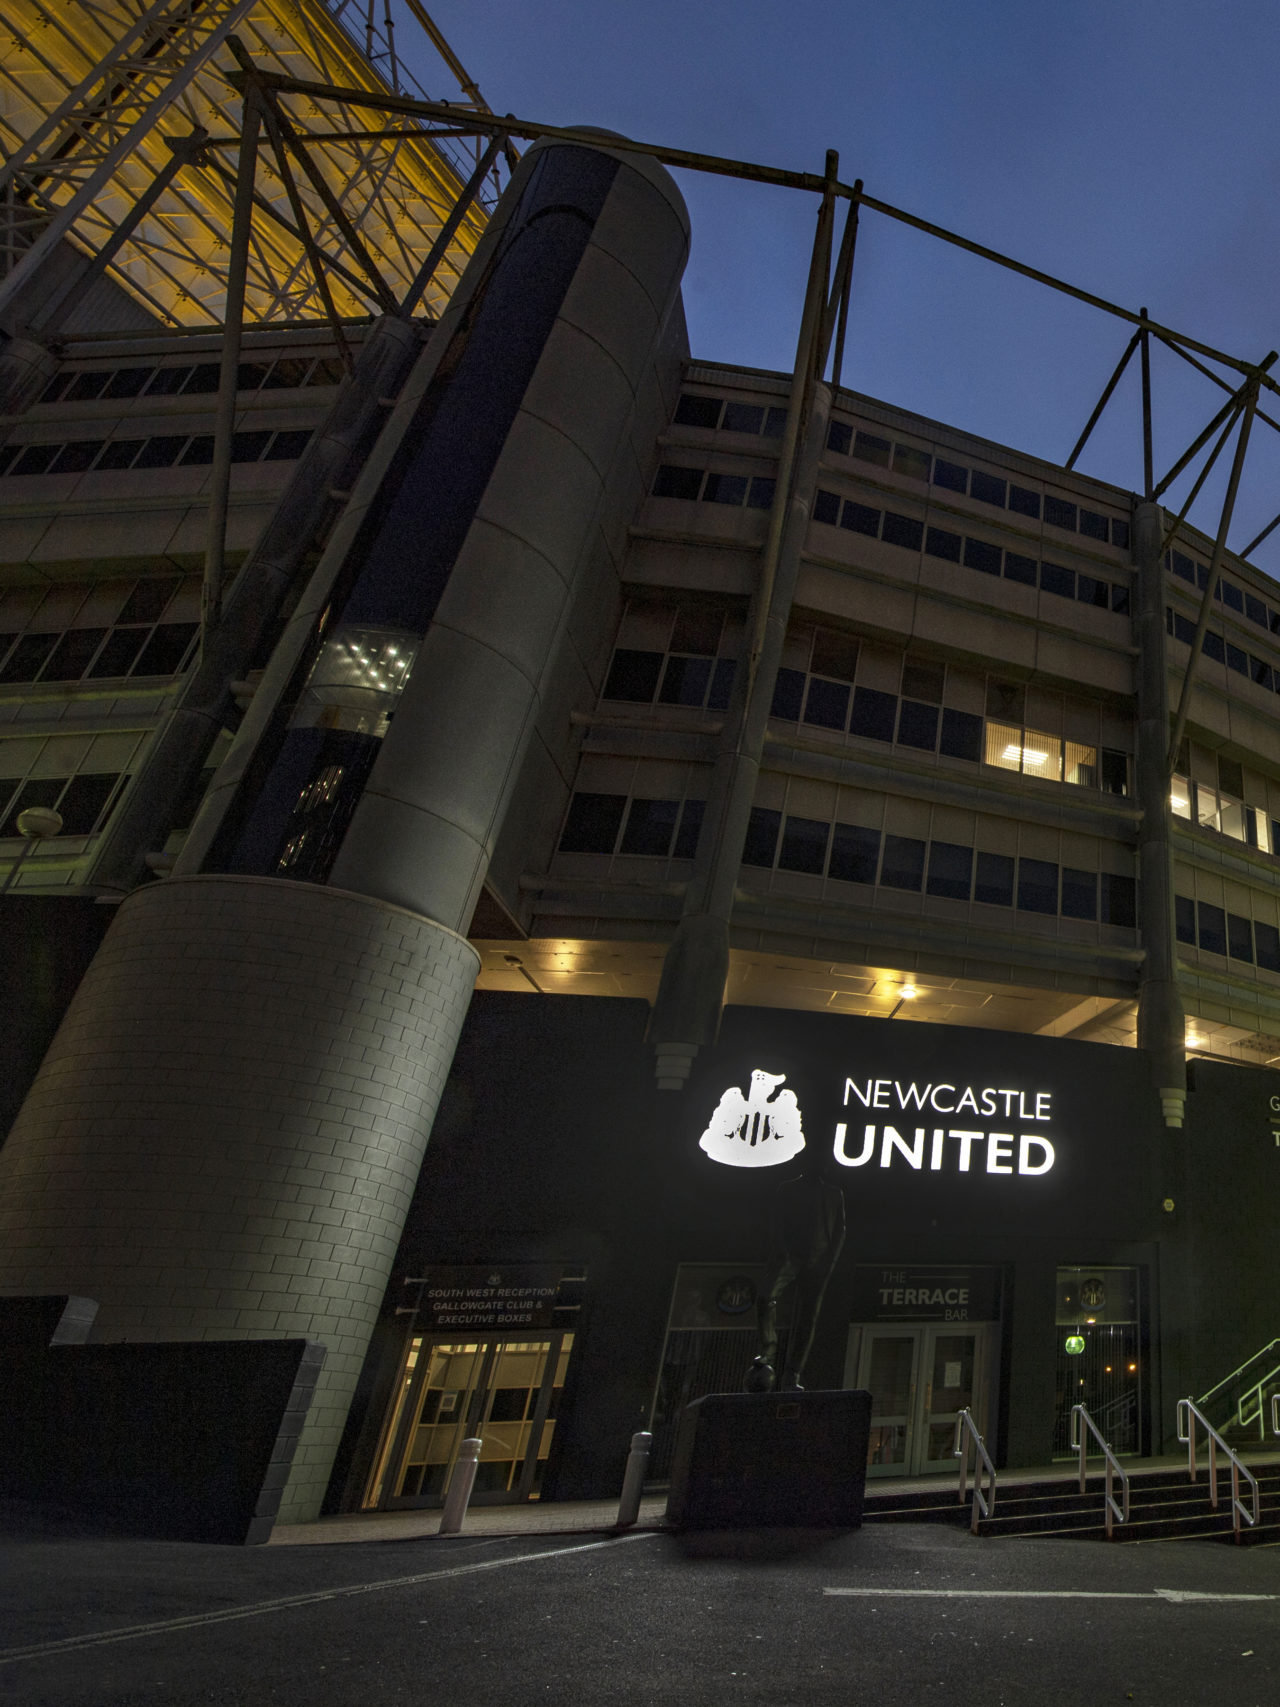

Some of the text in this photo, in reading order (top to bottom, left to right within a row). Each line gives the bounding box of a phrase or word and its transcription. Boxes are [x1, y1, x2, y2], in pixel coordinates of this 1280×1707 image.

[843, 1077, 1052, 1121] NEWCASTLE
[833, 1122, 1056, 1176] UNITED
[880, 1271, 907, 1283] THE
[428, 1287, 556, 1298] SOUTH WEST RECEPTION
[879, 1288, 969, 1305] TERRACE
[432, 1300, 543, 1311] GALLOWGATE CLUB &
[438, 1313, 533, 1324] EXECUTIVE BOXES
[944, 1308, 969, 1321] BAR
